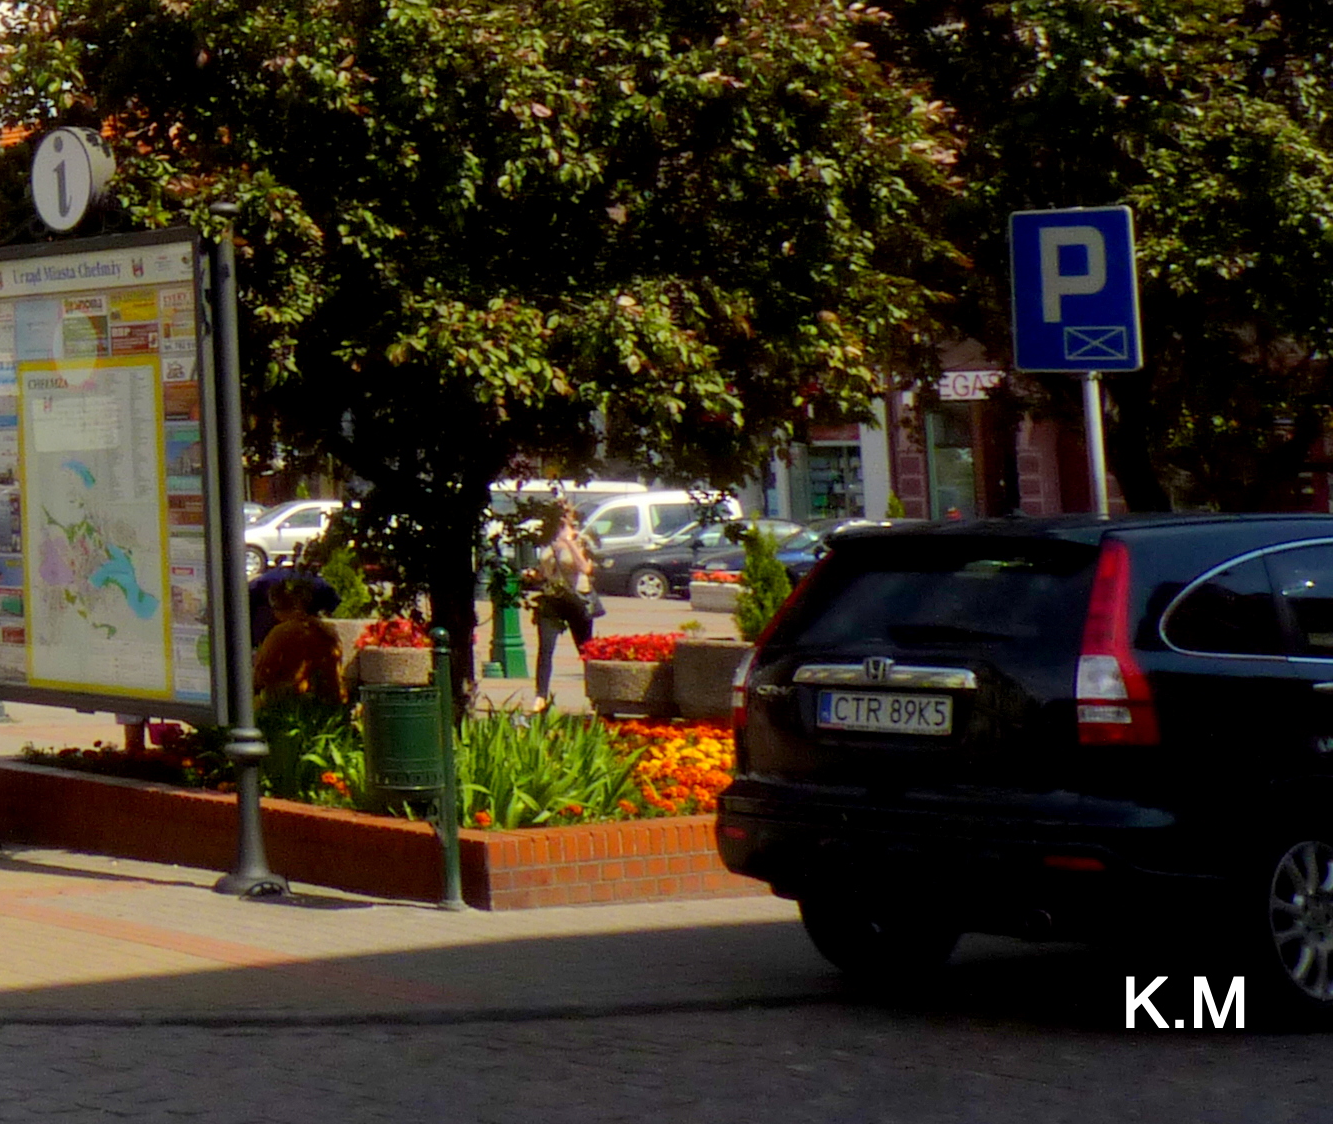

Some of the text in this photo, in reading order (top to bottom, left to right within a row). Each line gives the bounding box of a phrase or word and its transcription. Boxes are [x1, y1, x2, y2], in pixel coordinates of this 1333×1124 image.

[44, 265, 76, 282] Miasta
[1039, 225, 1107, 322] P
[834, 696, 947, 727] CTR 89K5
